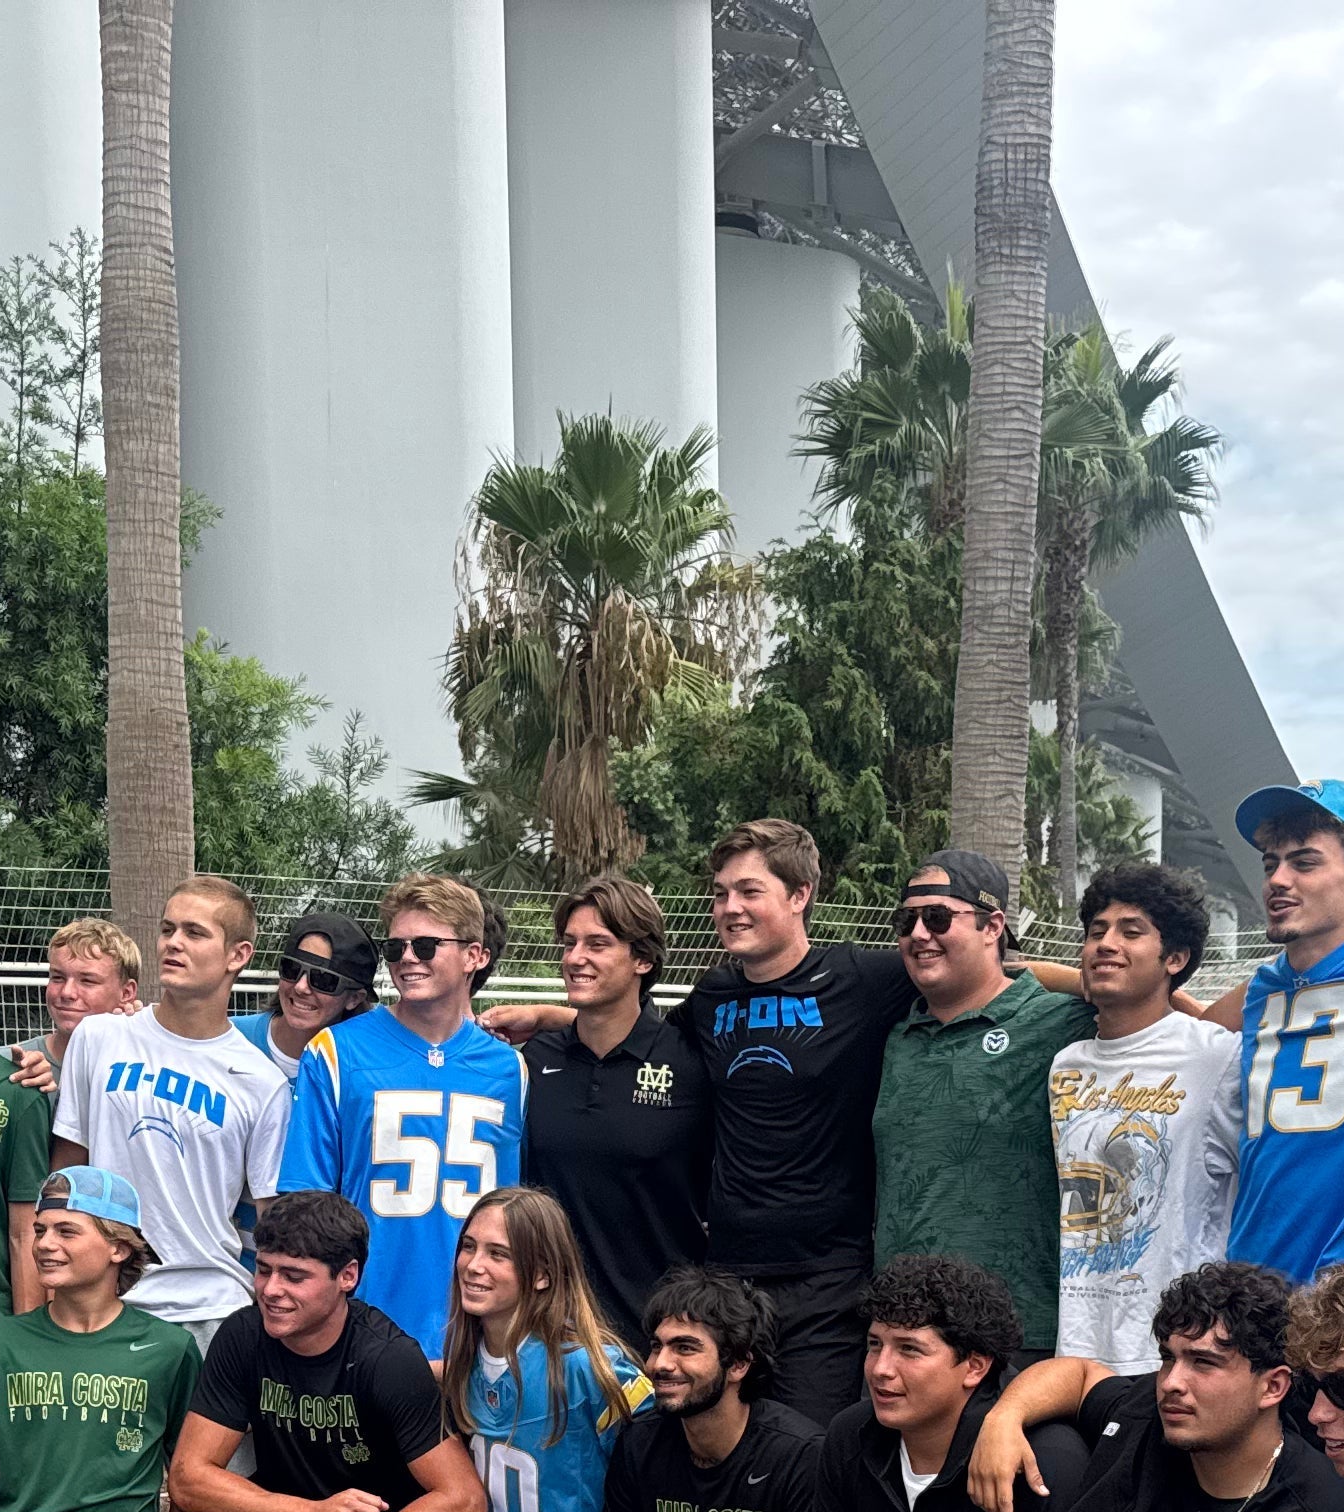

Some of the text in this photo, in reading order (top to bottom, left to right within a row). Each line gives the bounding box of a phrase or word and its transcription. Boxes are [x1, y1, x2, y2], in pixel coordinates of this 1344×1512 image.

[713, 995, 823, 1037] 11-ON
[105, 1062, 226, 1128] 11-ON
[1105, 1071, 1186, 1124] Angeles
[370, 1091, 505, 1218] 55
[7, 1371, 148, 1413] MIRA COSTA
[300, 1394, 359, 1429] COSTA
[9, 1405, 144, 1428] FOOTBALL
